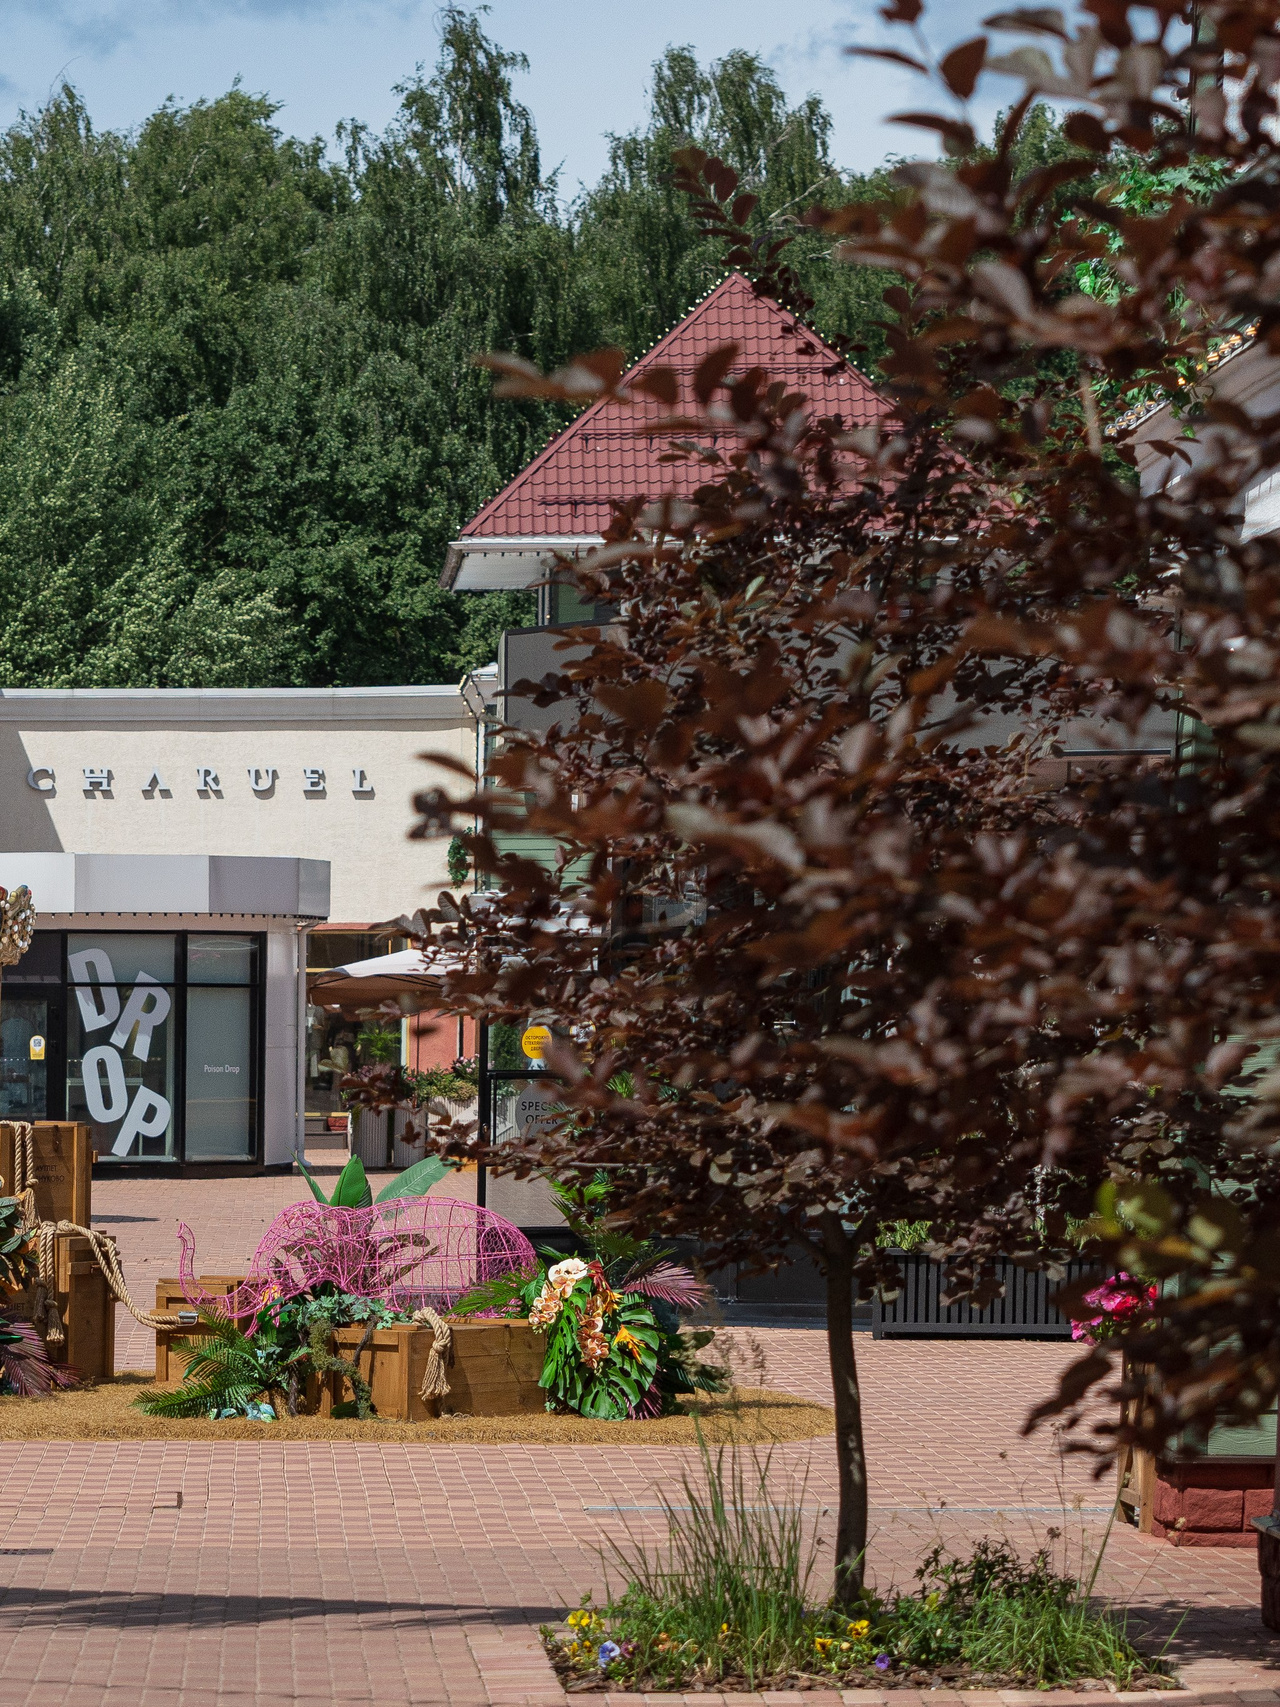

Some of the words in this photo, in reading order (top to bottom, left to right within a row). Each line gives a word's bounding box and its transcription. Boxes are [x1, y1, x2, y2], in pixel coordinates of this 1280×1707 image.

[27, 768, 374, 791] CHARUEL
[204, 1064, 223, 1073] Poison
[225, 1064, 240, 1074] Drop
[521, 1101, 556, 1111] SPEC
